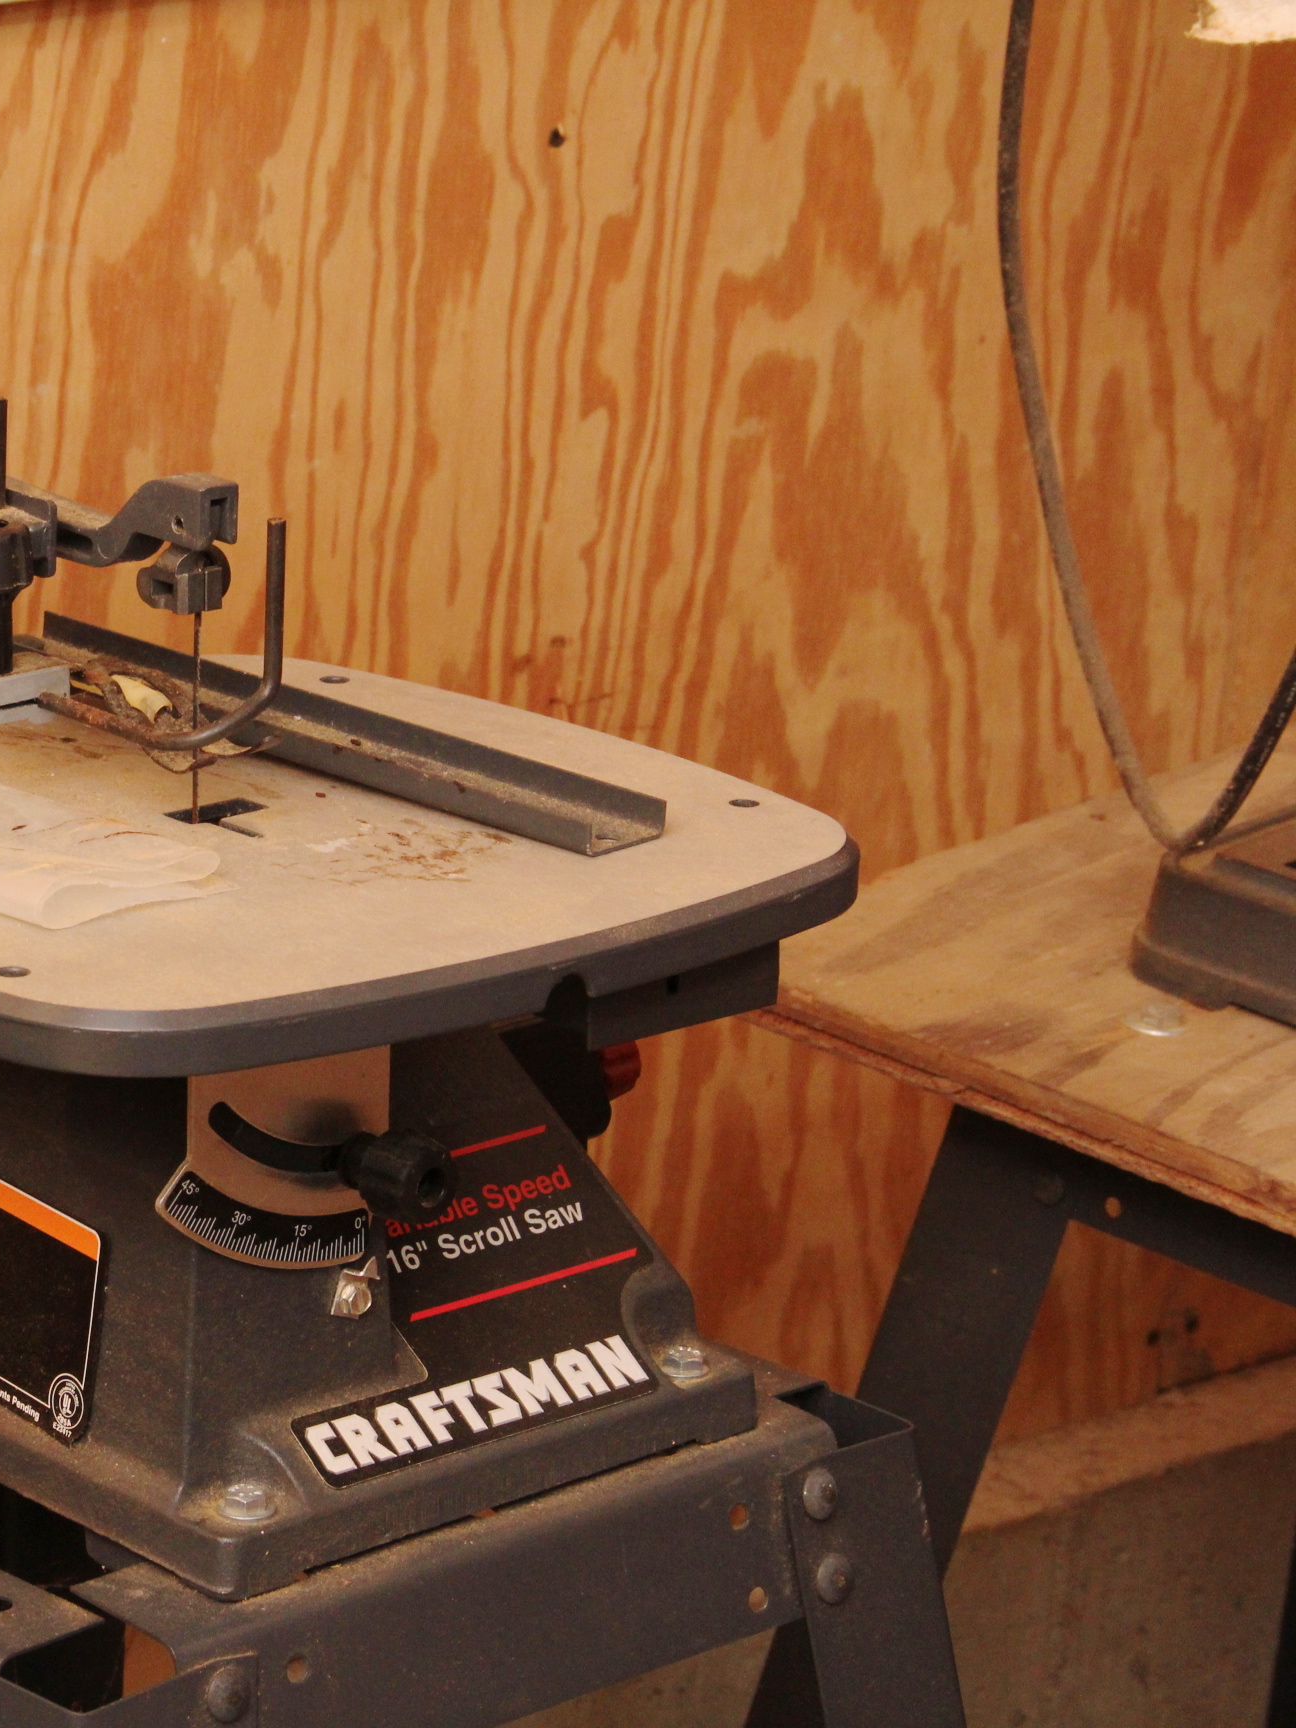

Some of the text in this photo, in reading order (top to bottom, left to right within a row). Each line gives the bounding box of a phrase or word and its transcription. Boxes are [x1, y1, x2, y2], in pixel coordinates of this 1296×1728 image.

[482, 1164, 572, 1211] Speed
[386, 1201, 584, 1274] 16" Scroll Saw
[11, 1395, 40, 1423] Pending
[304, 1334, 650, 1476] CRAFTSMAN
